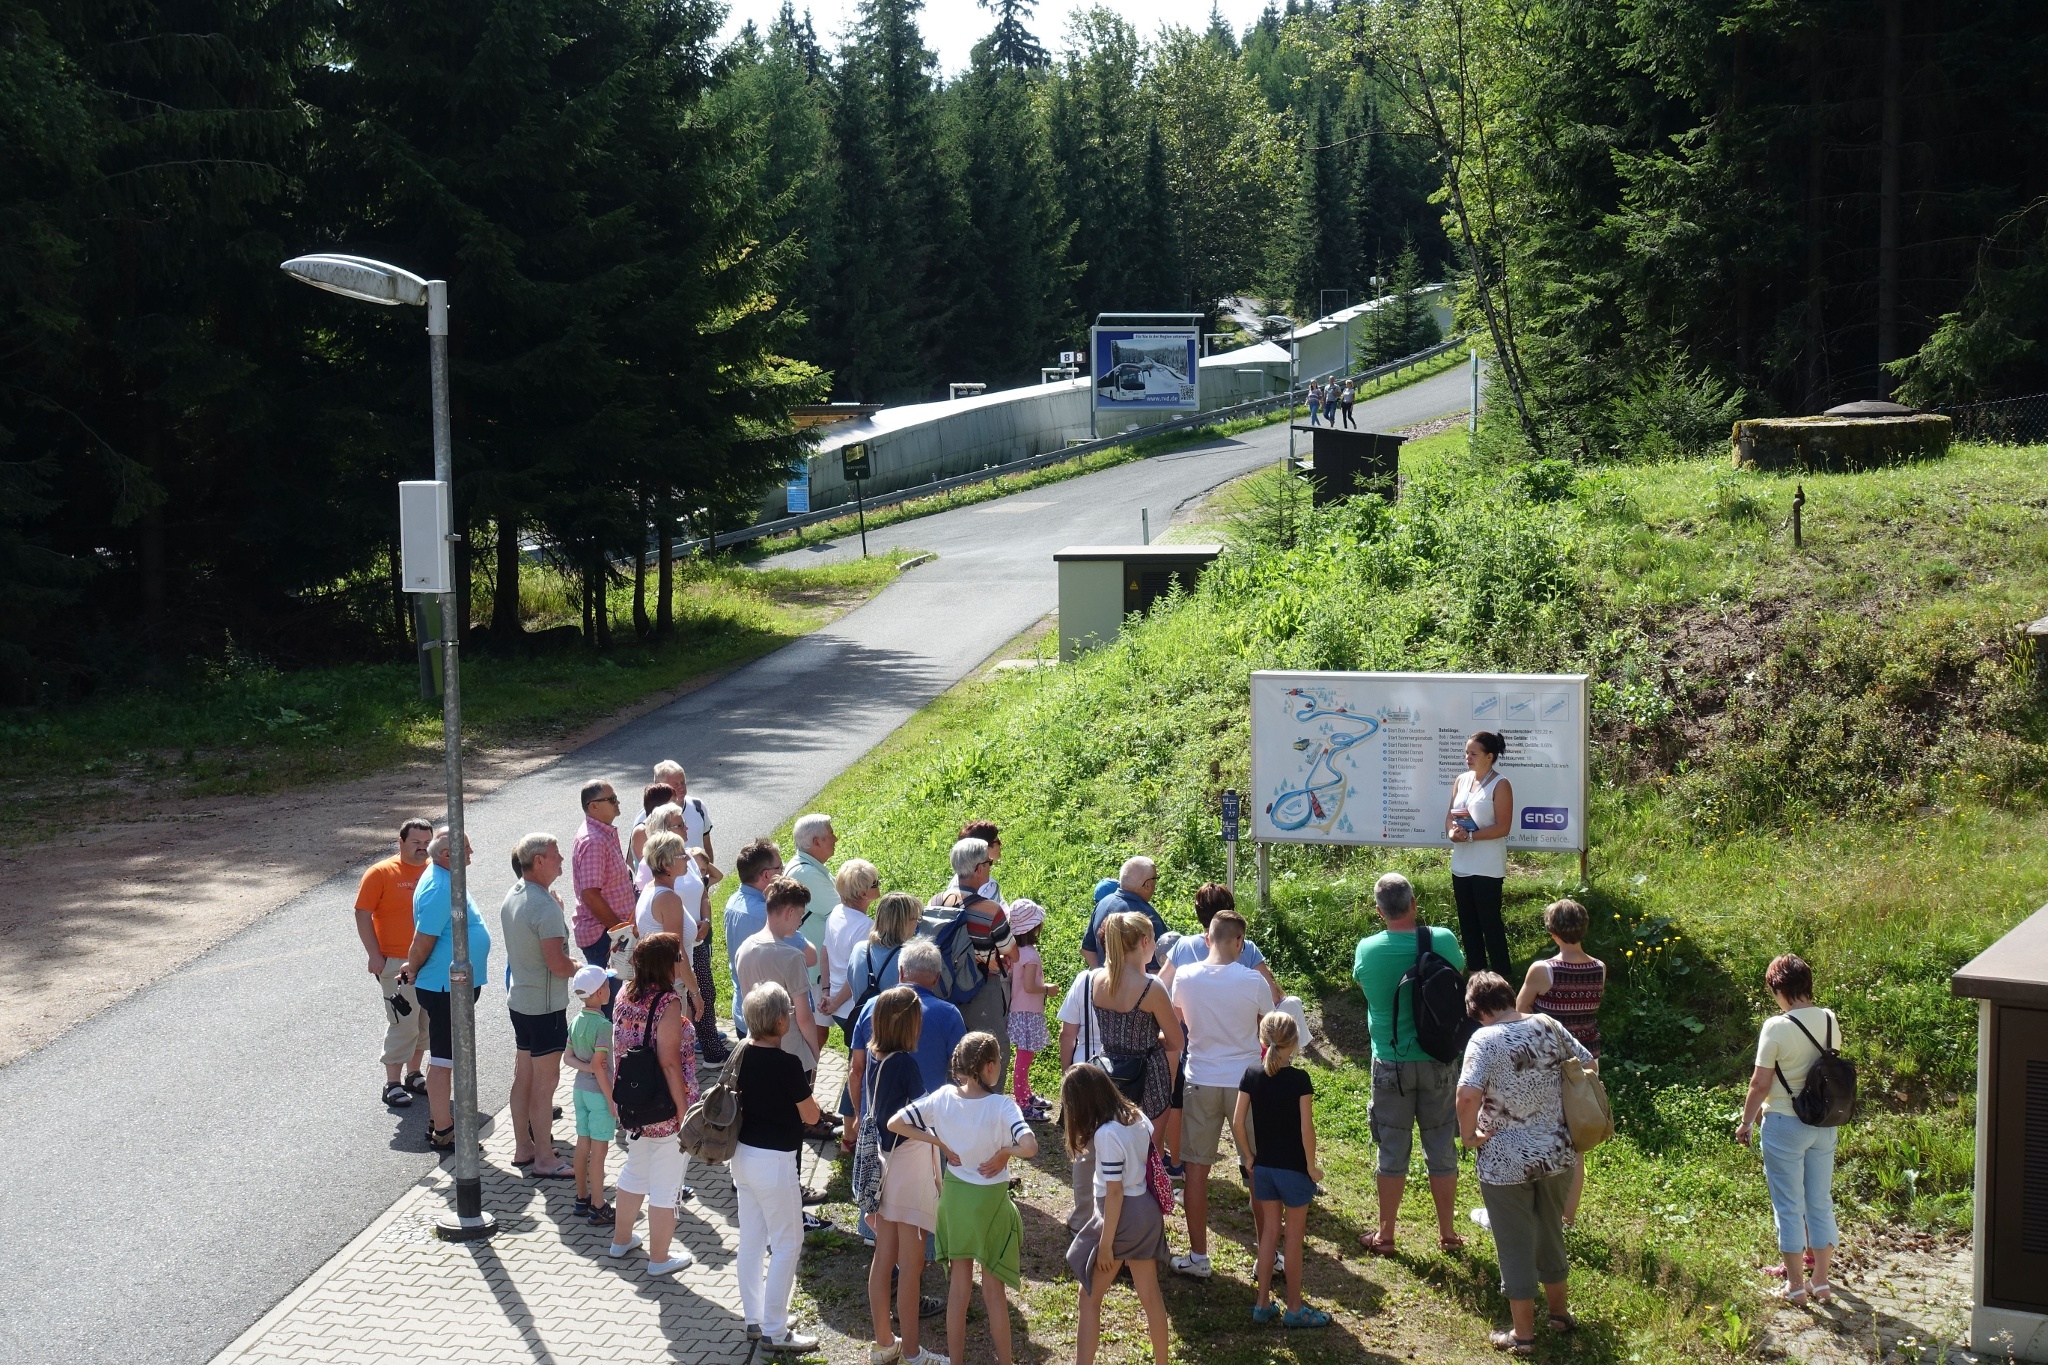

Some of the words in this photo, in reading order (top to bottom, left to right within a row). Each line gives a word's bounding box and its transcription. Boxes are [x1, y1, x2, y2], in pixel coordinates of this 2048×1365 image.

[1077, 353, 1083, 361] 8
[1519, 834, 1538, 842] Mehr
[1541, 835, 1570, 843] Service.
